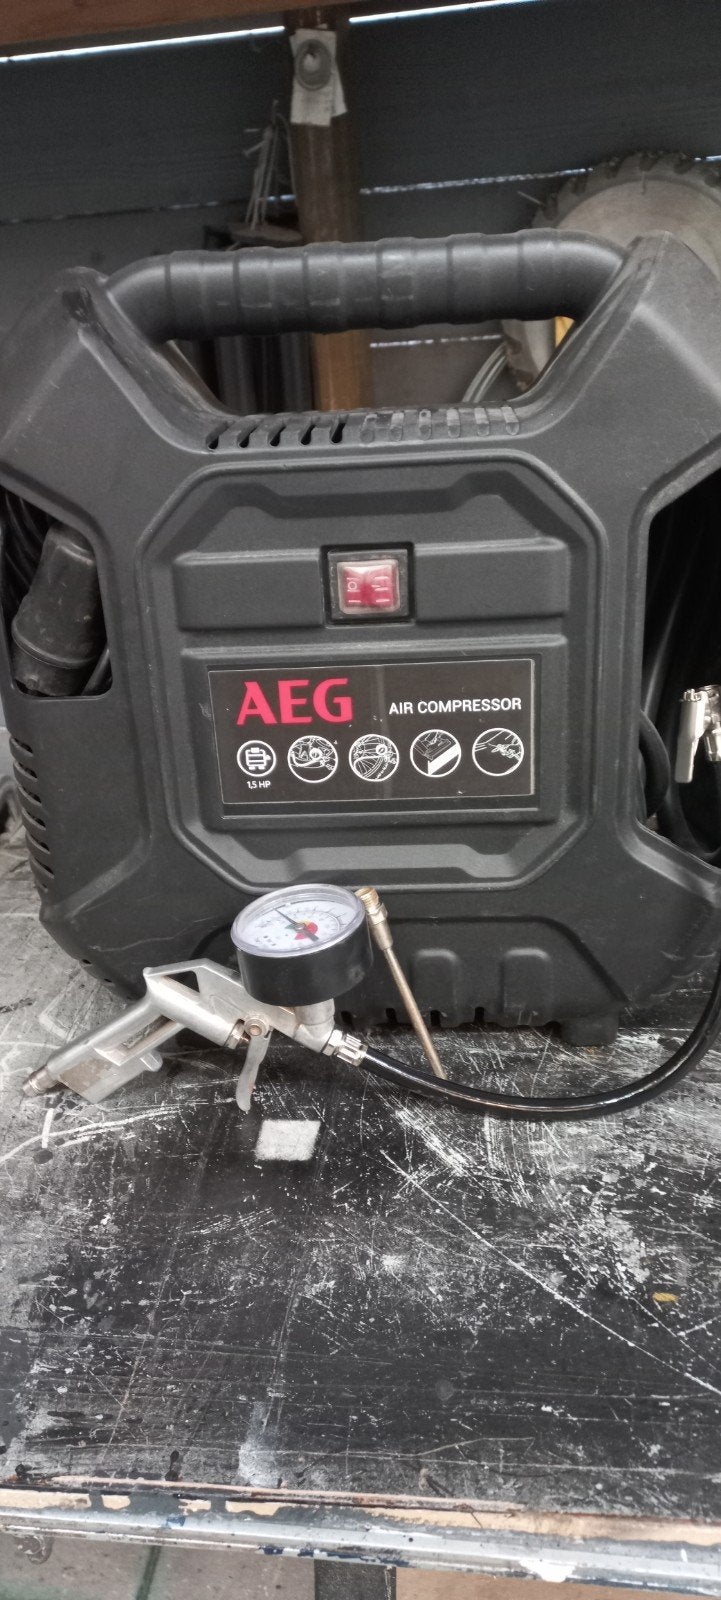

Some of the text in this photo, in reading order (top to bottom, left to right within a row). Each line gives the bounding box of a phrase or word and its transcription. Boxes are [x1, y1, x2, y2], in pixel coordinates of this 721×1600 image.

[236, 678, 353, 725] AEG
[389, 698, 522, 715] AIR COMPRESSOR
[258, 780, 271, 788] HP
